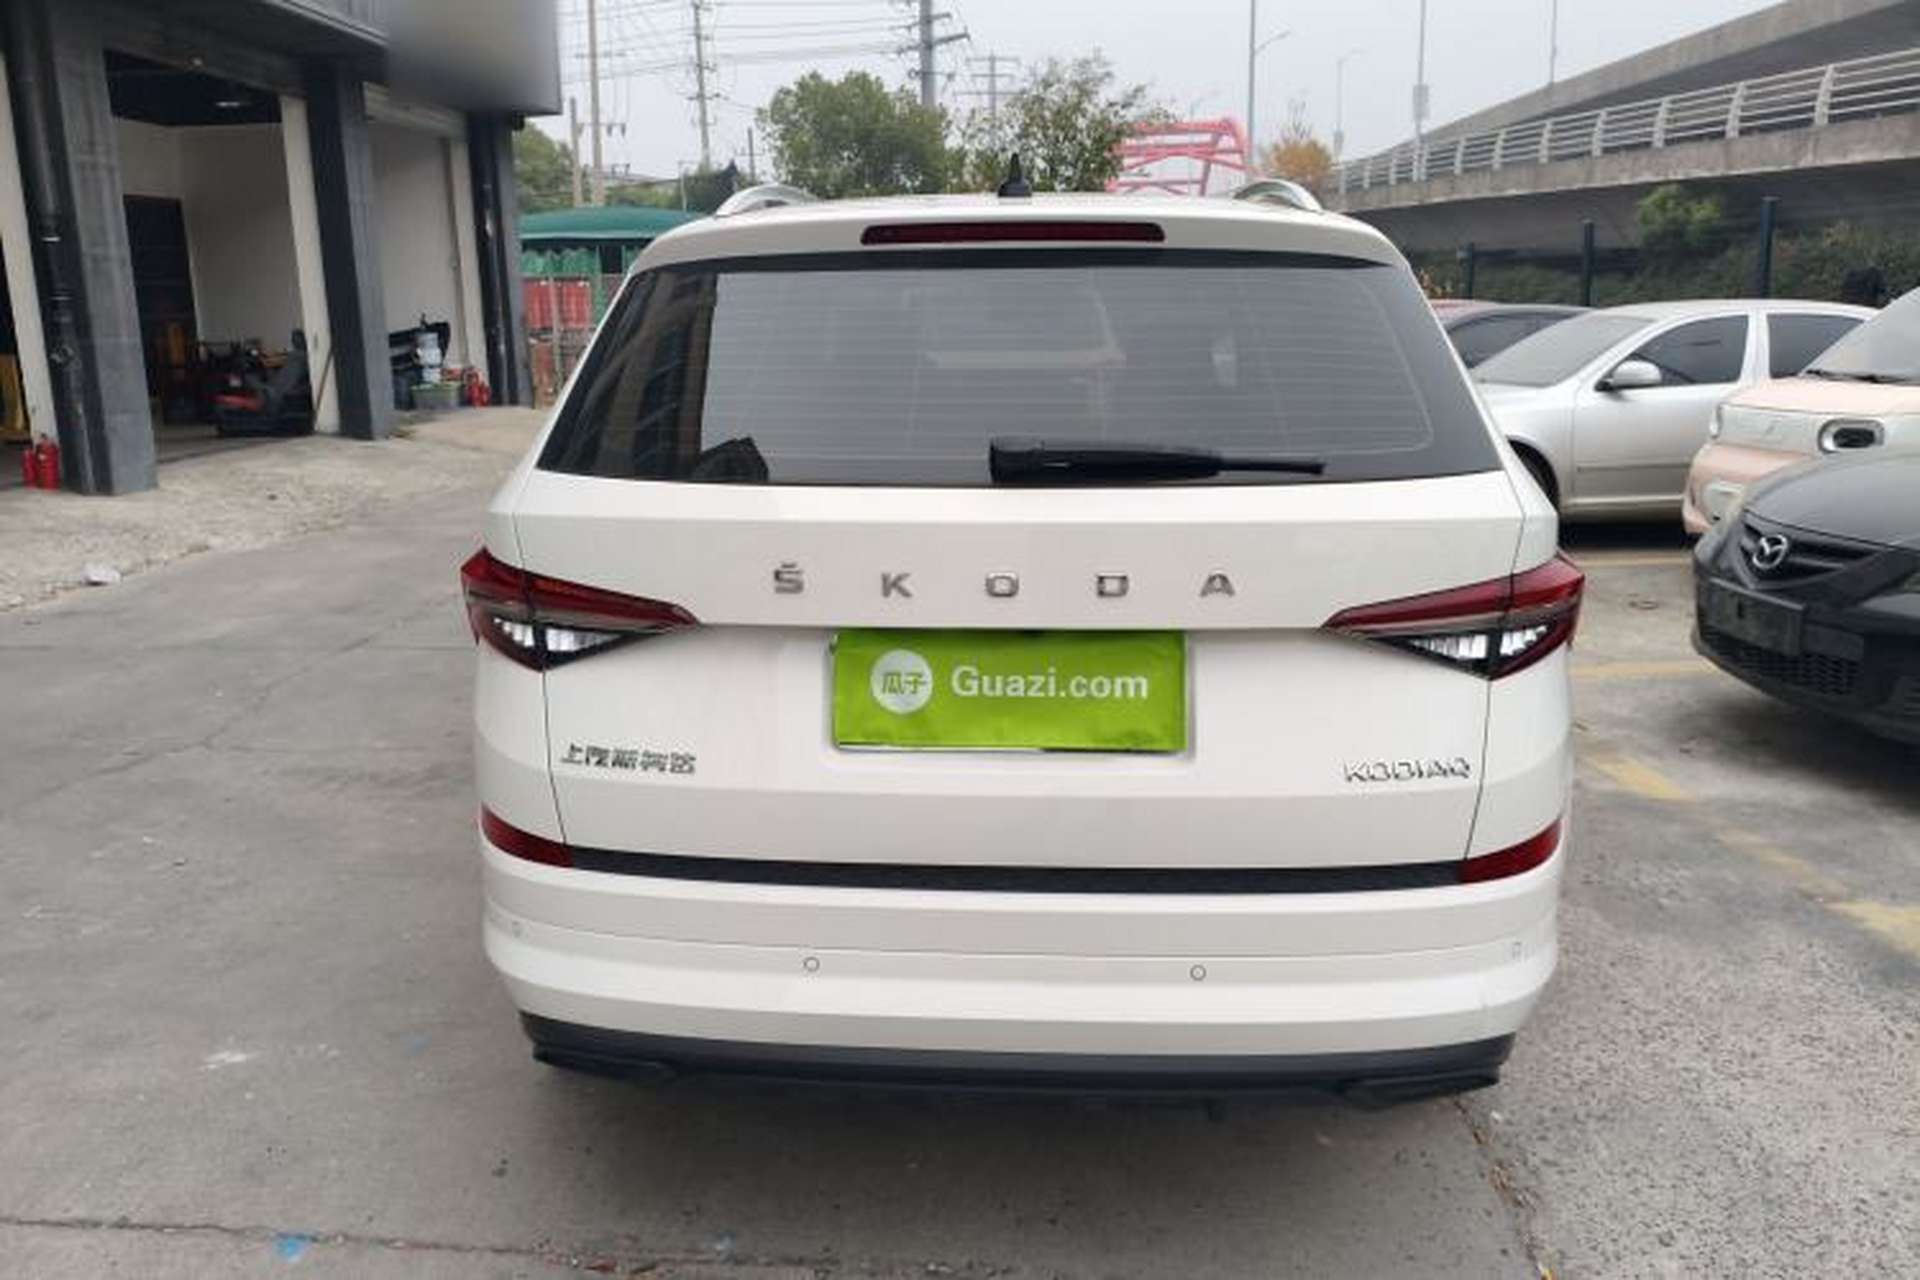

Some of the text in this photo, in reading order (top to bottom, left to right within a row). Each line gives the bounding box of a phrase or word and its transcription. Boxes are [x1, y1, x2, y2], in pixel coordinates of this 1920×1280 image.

[881, 671, 928, 695] 瓜子
[951, 664, 1149, 699] Guazi.com
[1343, 757, 1471, 782] KODIAQ
